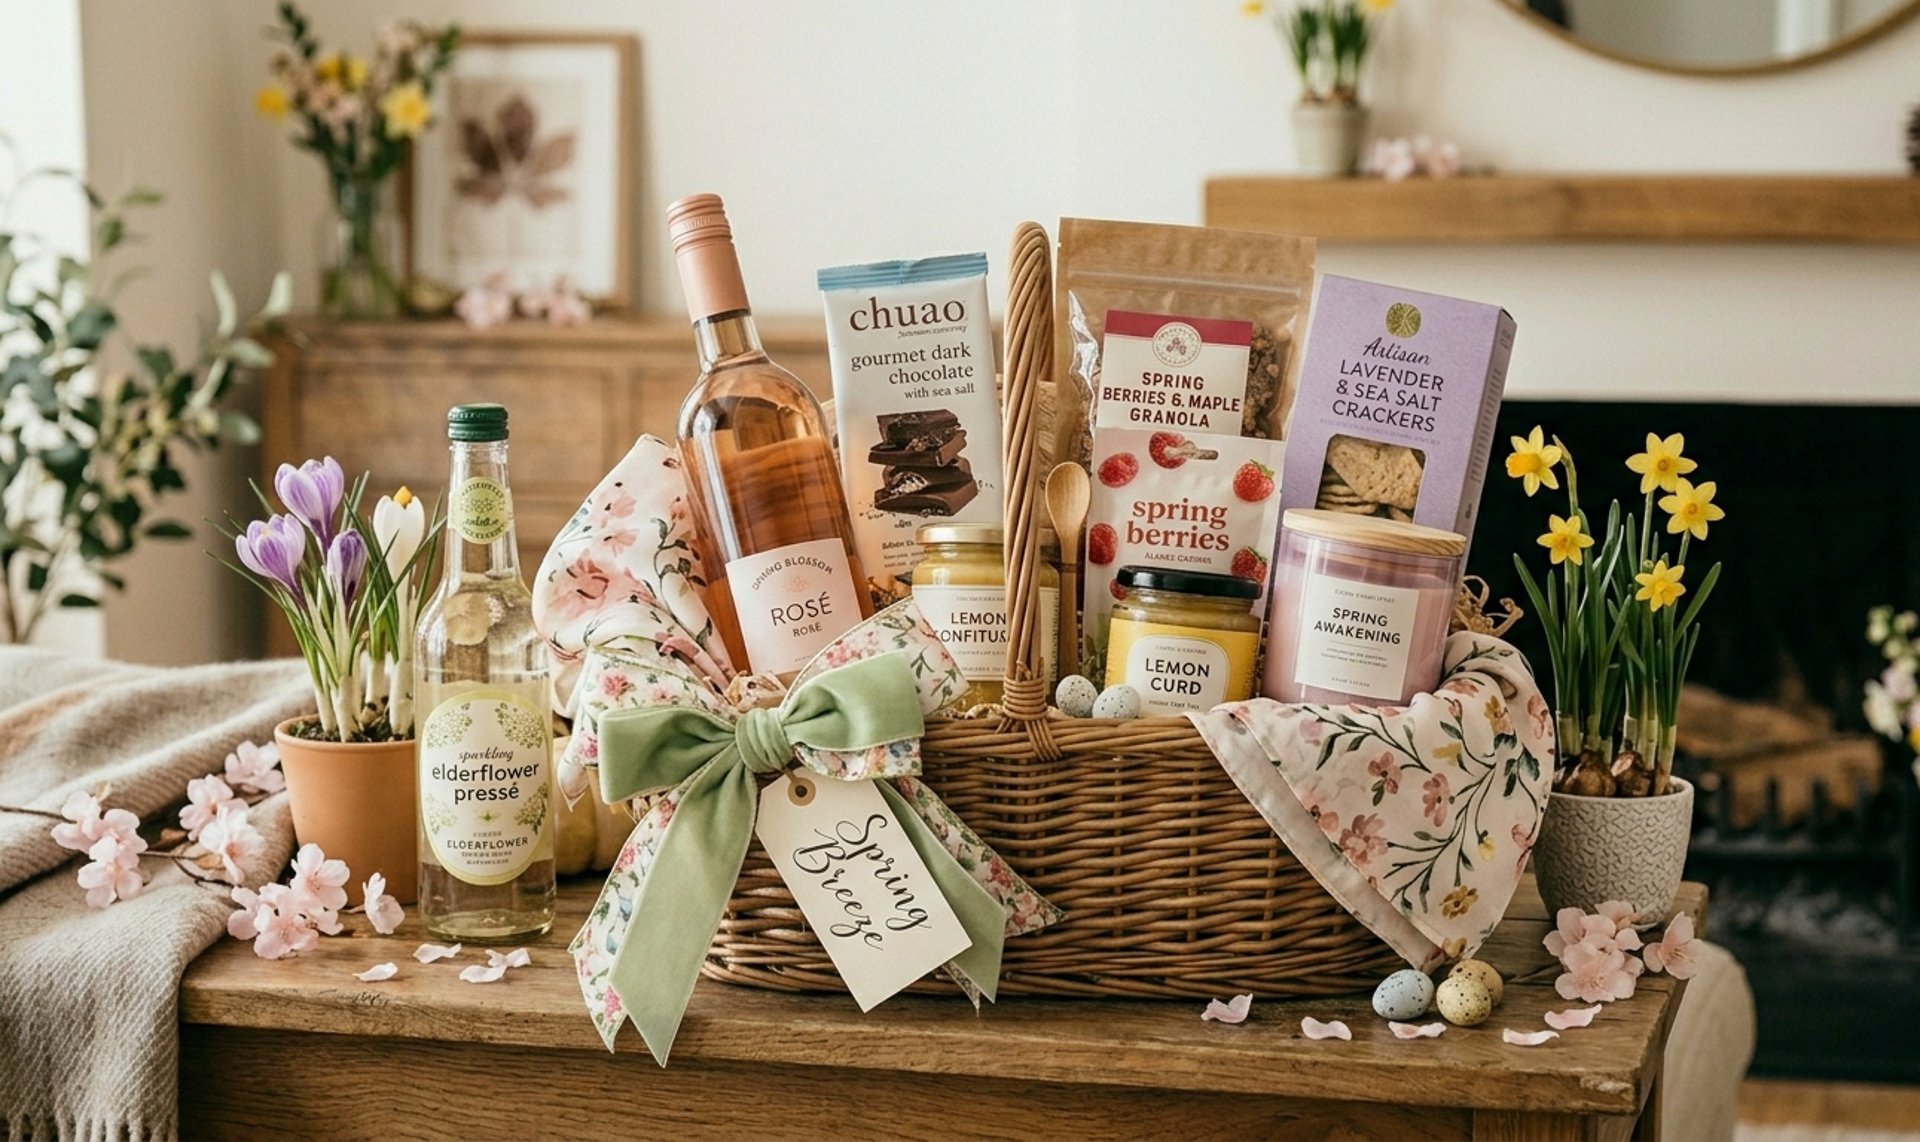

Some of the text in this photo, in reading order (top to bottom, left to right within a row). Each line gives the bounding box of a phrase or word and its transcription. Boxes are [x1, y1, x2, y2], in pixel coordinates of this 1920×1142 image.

[849, 296, 965, 332] chuao
[851, 342, 972, 371] gourmet dark
[1363, 337, 1431, 366] Artisan
[889, 365, 974, 385] chocolate
[1141, 372, 1204, 390] SPRING
[1340, 359, 1444, 392] LAVENDER
[903, 387, 929, 399] with
[932, 388, 951, 397] sea
[1103, 387, 1166, 406] BERRIES
[1189, 394, 1241, 412] MAPLE
[1336, 379, 1443, 412] & SEA SALT
[1130, 408, 1210, 428] GRANOLA
[1332, 400, 1436, 433] CRACKERS
[1132, 497, 1228, 530] spring
[1127, 520, 1230, 551] berries
[770, 591, 833, 627] ROSÉ
[951, 612, 1006, 625] LEMON
[1332, 607, 1388, 627] SPRING
[1314, 620, 1401, 645] AWAKENING
[1145, 657, 1210, 678] LEMON
[1151, 677, 1202, 695] CURD
[459, 747, 514, 763] sparkling
[432, 763, 539, 782] elderflower
[454, 782, 519, 805] pressé
[835, 814, 932, 932] Spring
[792, 828, 884, 951] Breeze
